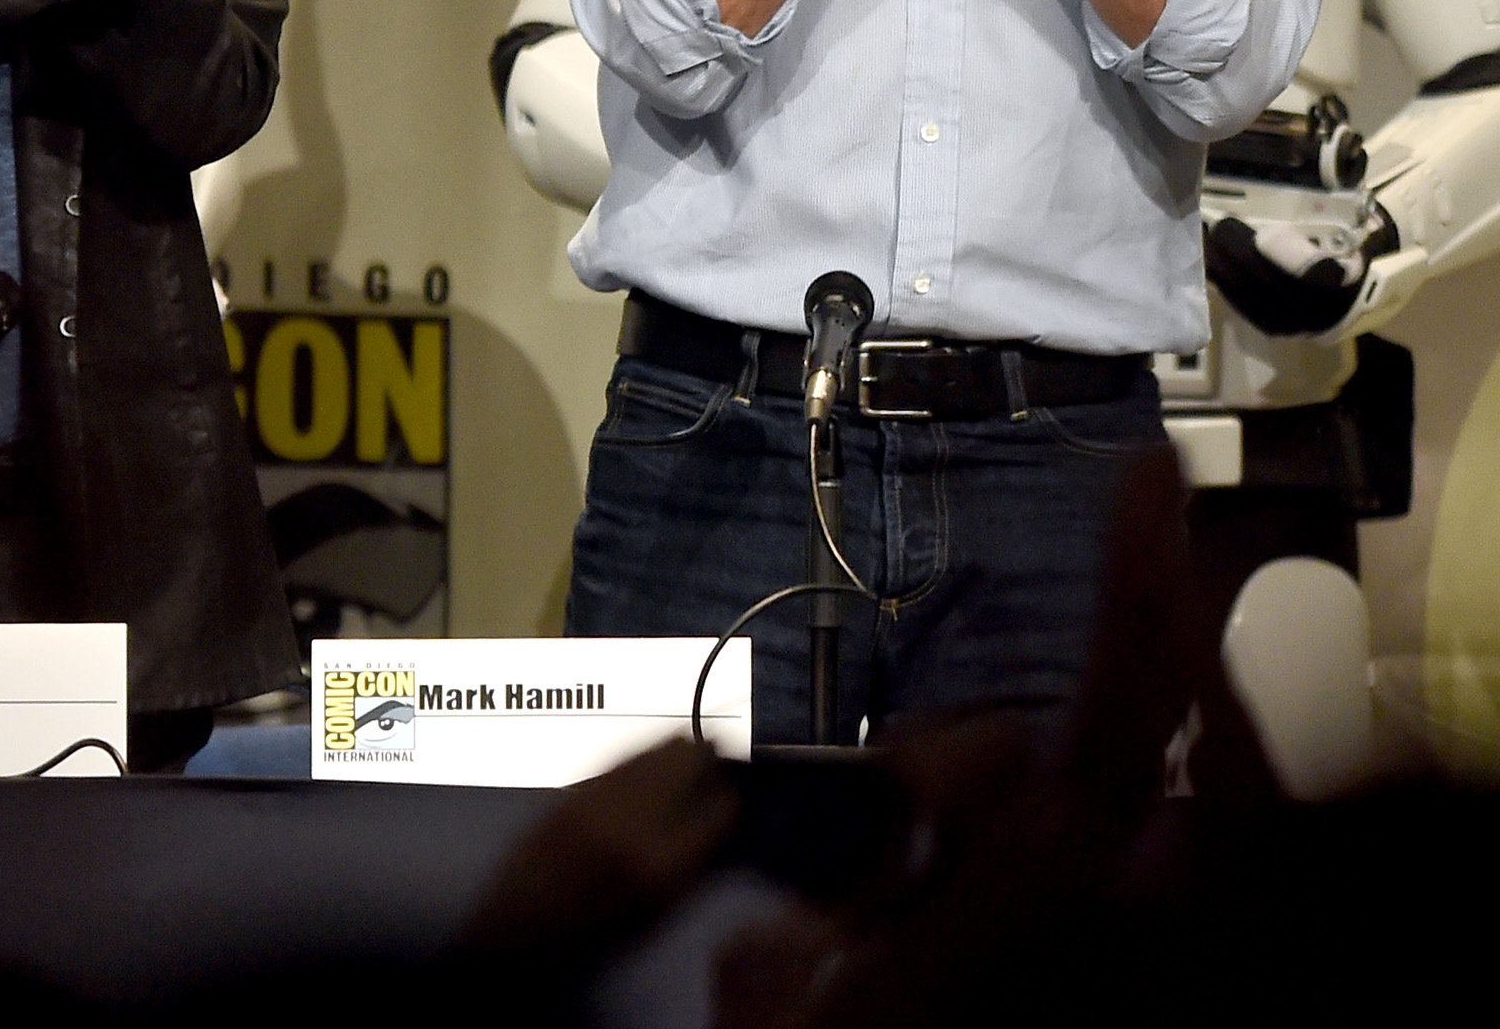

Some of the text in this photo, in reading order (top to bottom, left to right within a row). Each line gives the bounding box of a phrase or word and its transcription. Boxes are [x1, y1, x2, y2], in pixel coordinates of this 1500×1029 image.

[225, 317, 445, 463] ON
[356, 671, 414, 697] CON
[419, 683, 605, 710] Mark Hamill
[325, 672, 356, 750] COMIC
[324, 752, 415, 763] INTERNATIONAL
